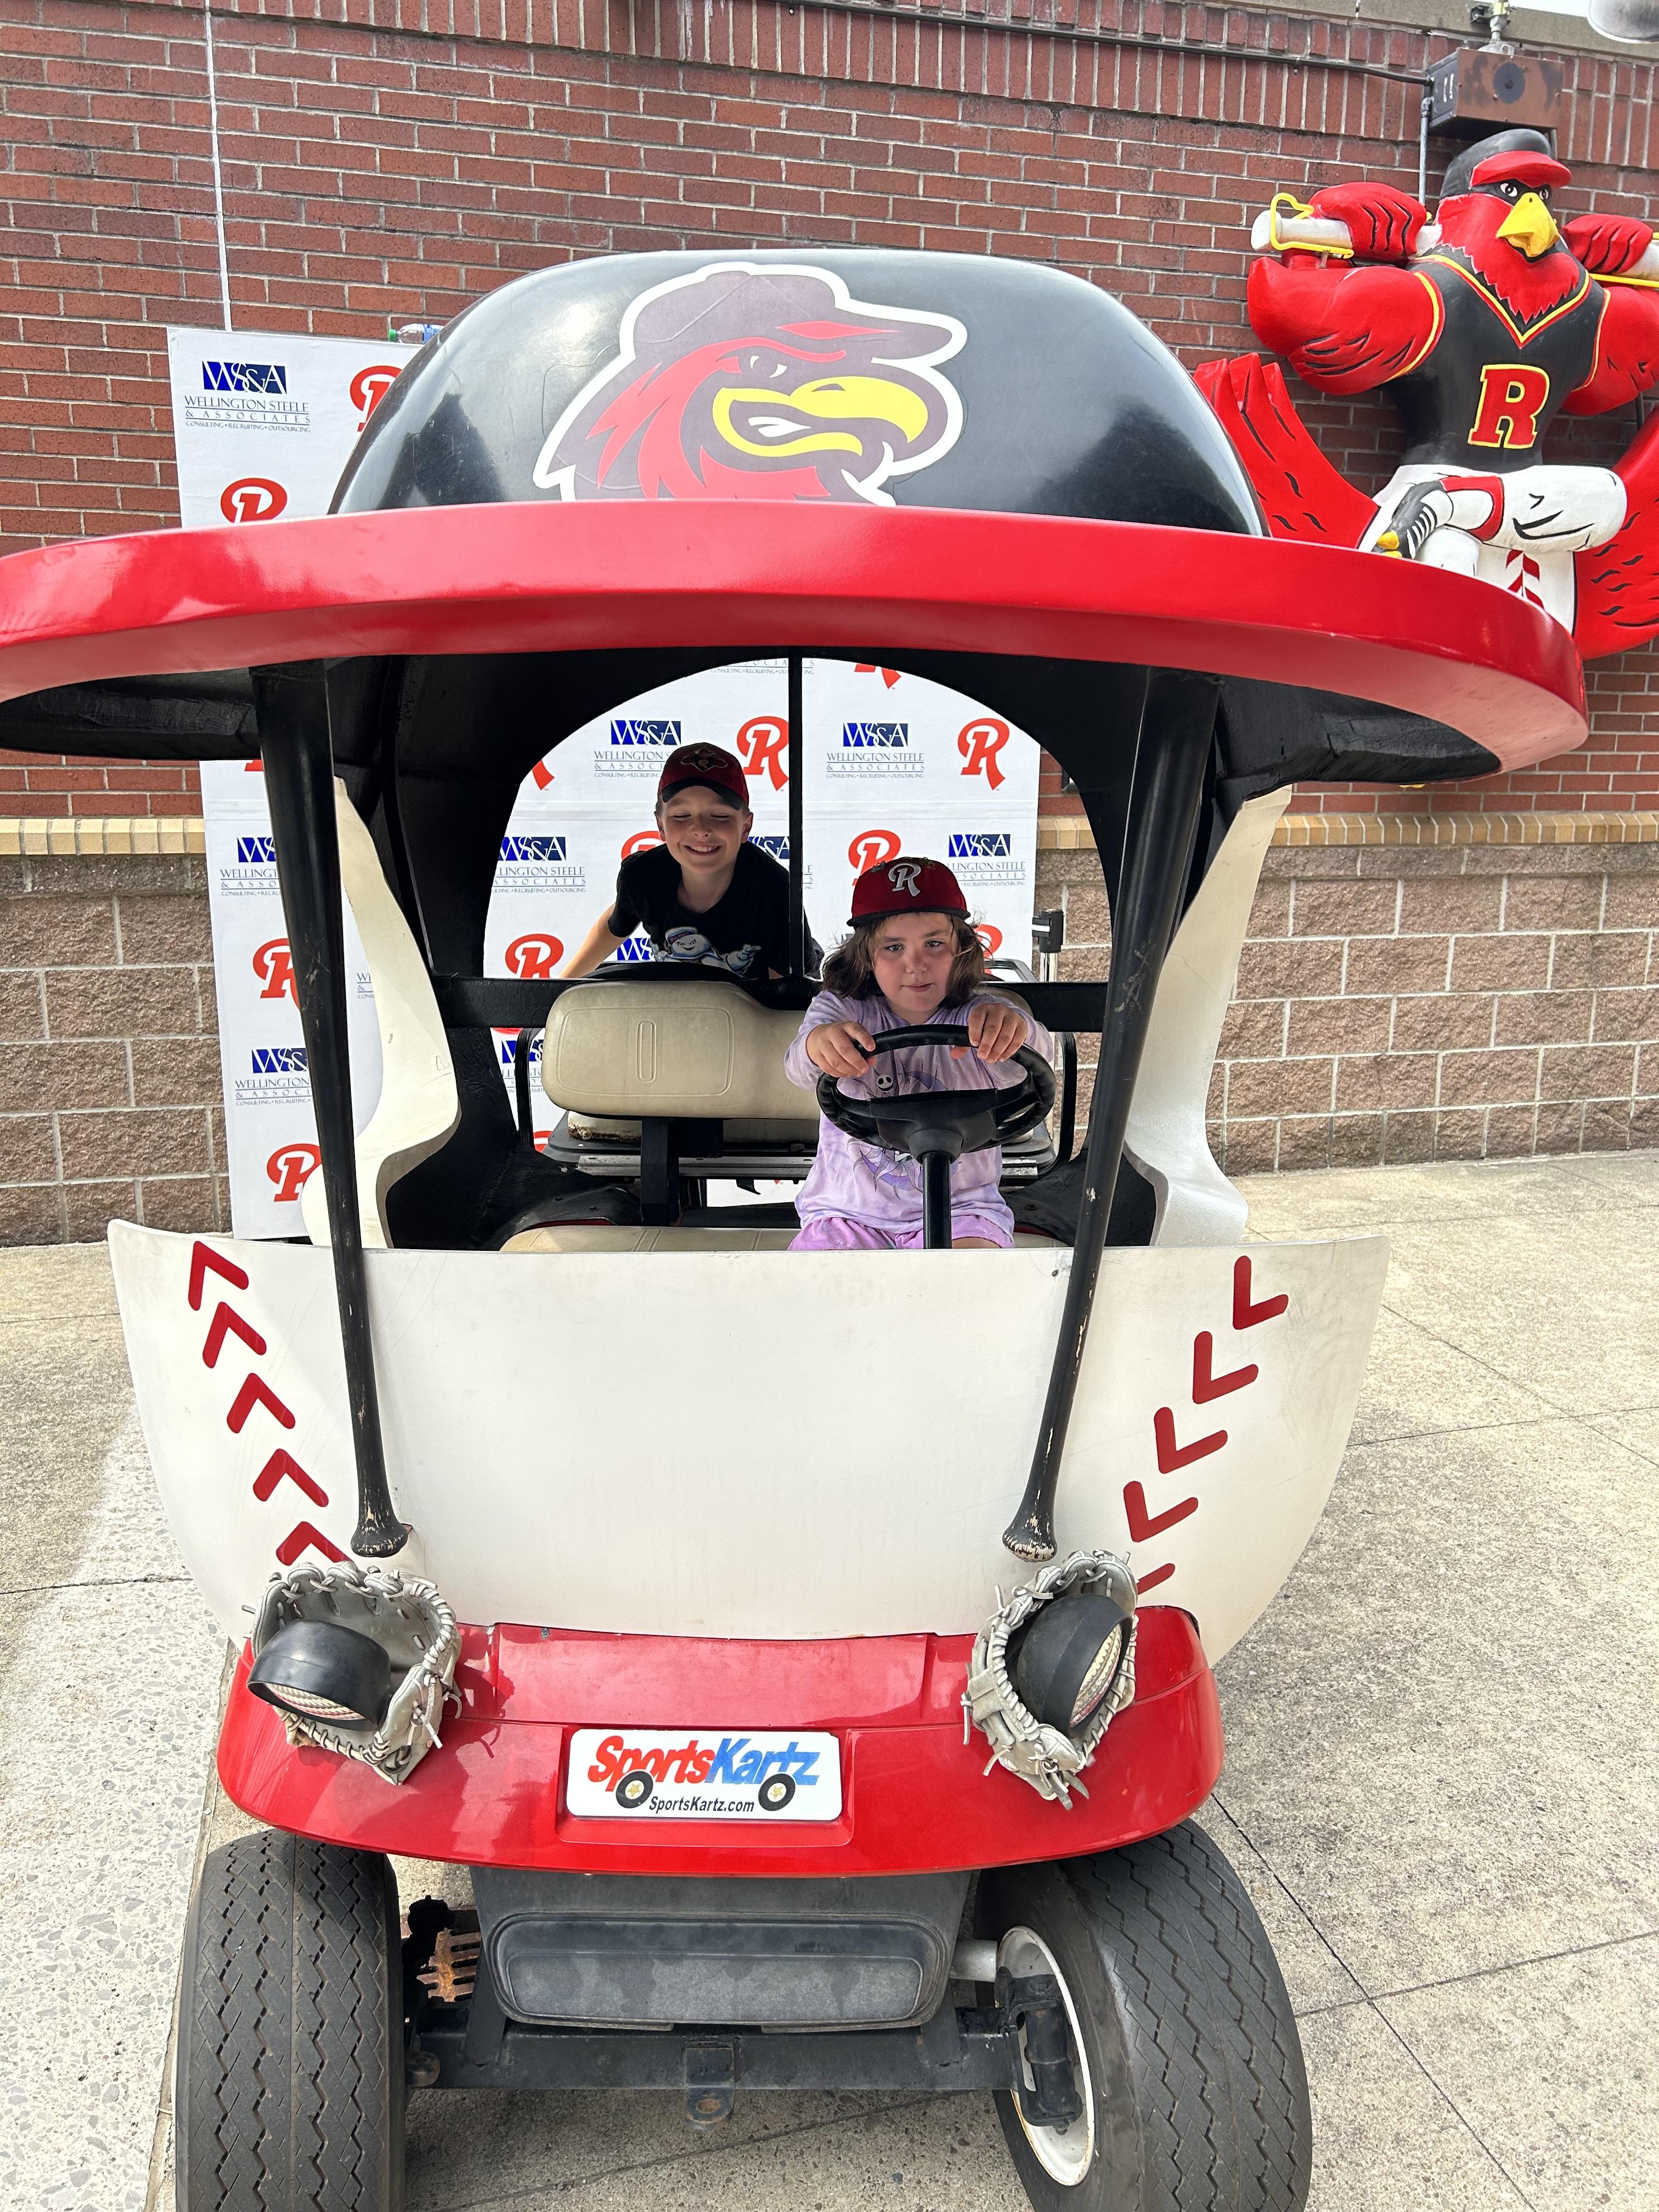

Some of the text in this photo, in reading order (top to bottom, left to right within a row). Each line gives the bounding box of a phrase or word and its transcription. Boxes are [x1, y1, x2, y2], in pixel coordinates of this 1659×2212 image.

[202, 360, 287, 394] WS&A
[184, 396, 309, 413] WELLINGTON STEELE
[1468, 363, 1550, 449] R
[185, 409, 311, 424] & ASSOCIATES
[186, 420, 224, 428] CONSULTING
[611, 720, 681, 745] WS&A
[843, 723, 909, 747] WS&A
[594, 751, 663, 760] WELLINGTON
[737, 716, 789, 791] R
[827, 753, 924, 761] WELLINGTON STEELE
[957, 718, 1009, 791] R
[237, 837, 276, 862] WS
[949, 834, 1011, 857] WS&A
[220, 869, 278, 878] WELLINGT
[495, 867, 585, 876] LINGTON STEELE
[947, 861, 1026, 871] LINGTON STEELE
[888, 862, 921, 896] R
[251, 1048, 309, 1073] WS&
[235, 1077, 309, 1088] WELLINGTON
[252, 1089, 309, 1097] ASSOCI
[588, 1735, 820, 1792] SportsKartz
[648, 1795, 755, 1814] SportsKartz.com
